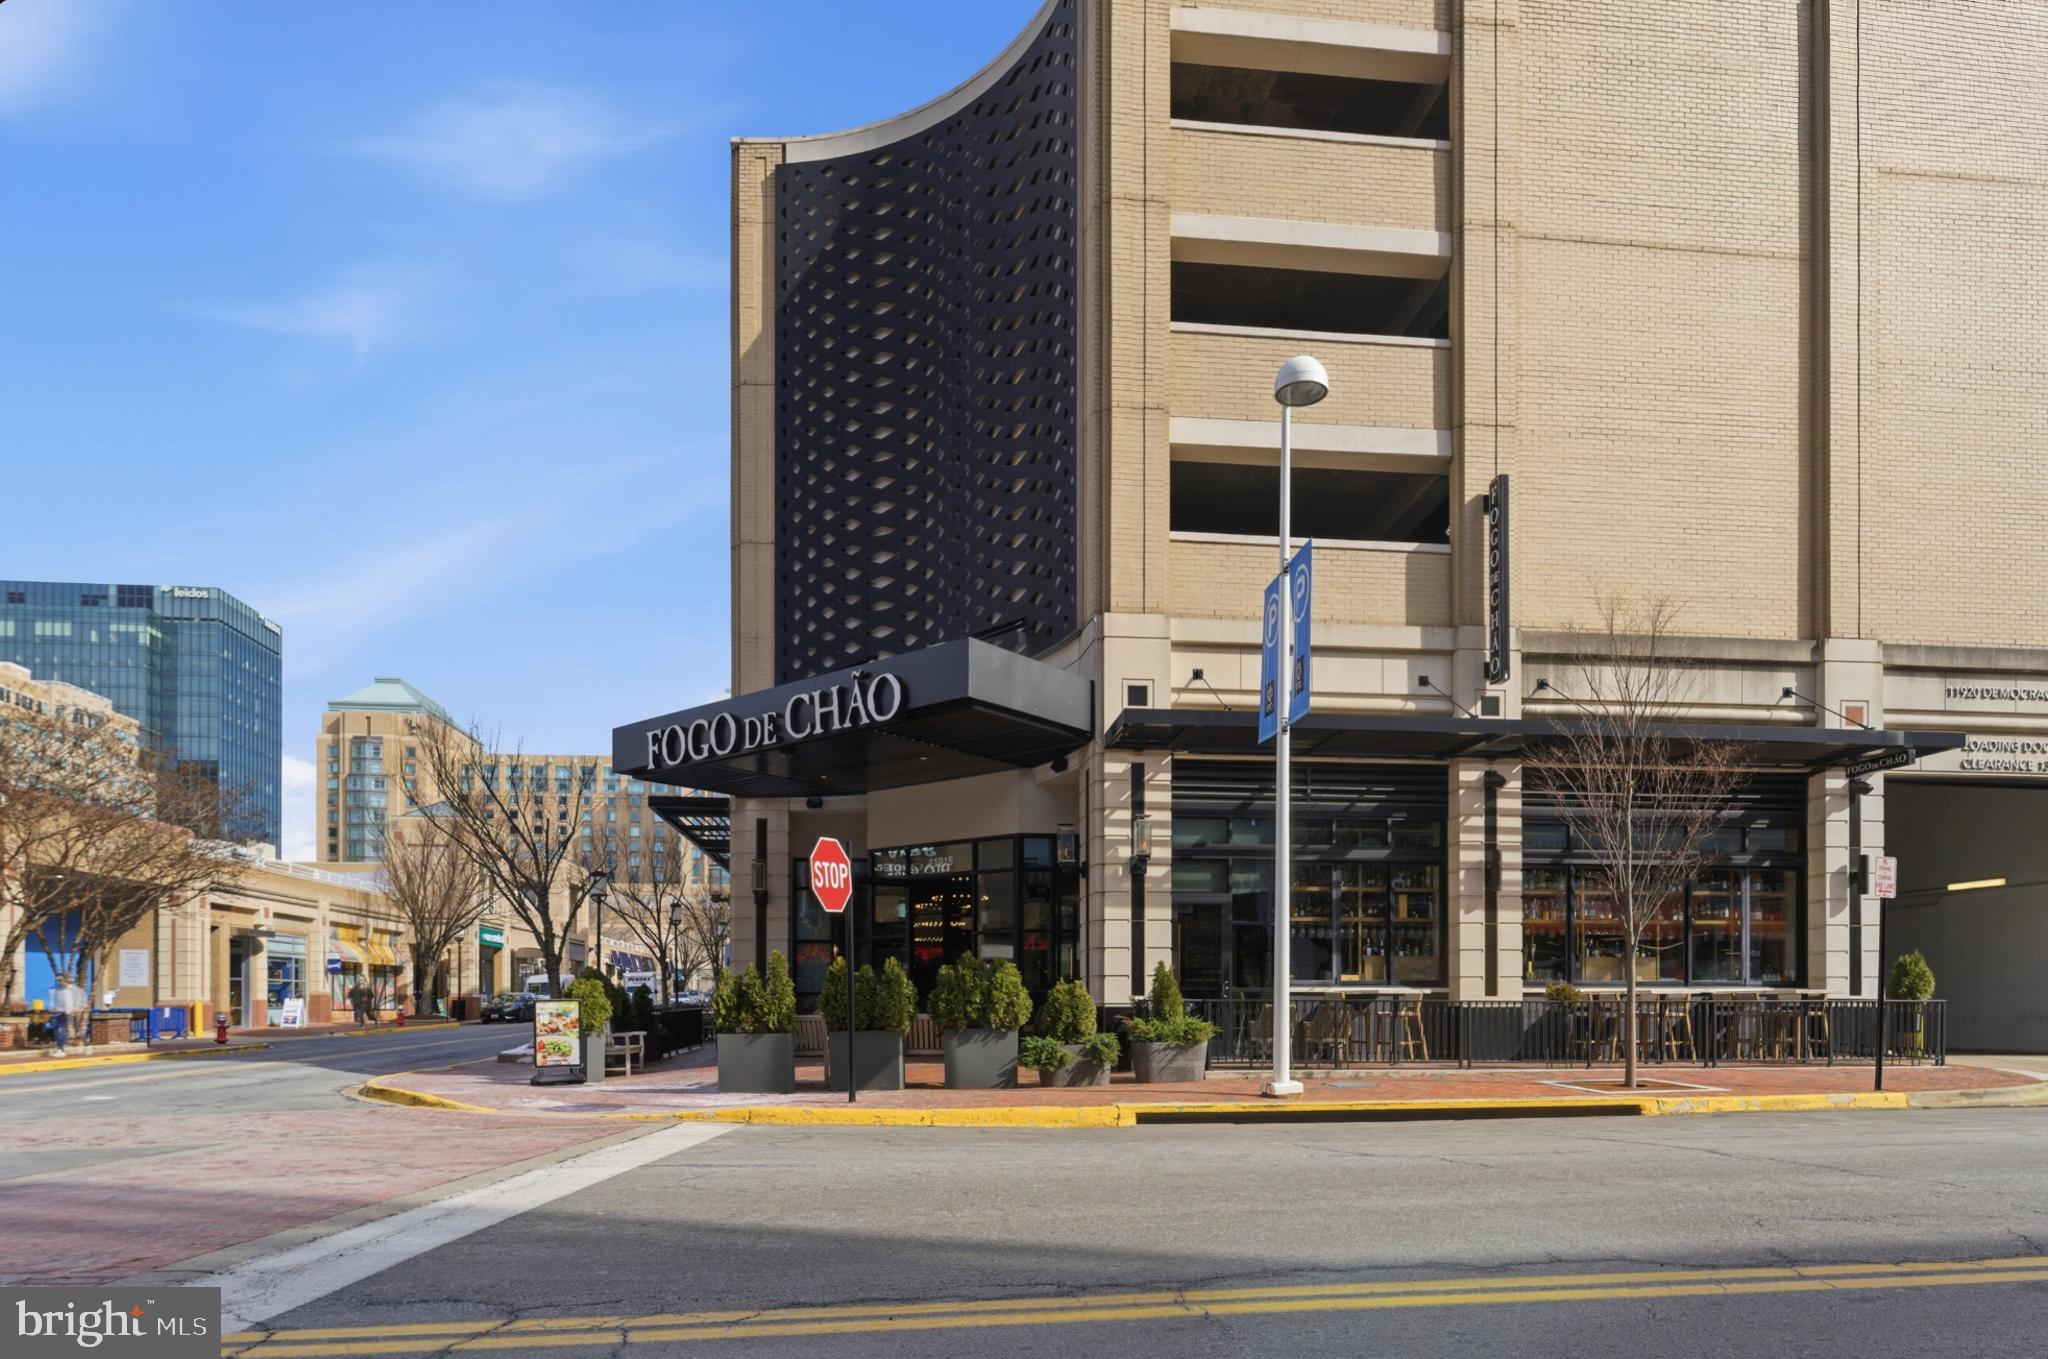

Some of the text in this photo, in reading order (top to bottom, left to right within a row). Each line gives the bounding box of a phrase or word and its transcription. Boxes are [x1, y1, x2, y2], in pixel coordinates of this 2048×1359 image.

[1489, 486, 1500, 568] FOGO
[173, 587, 209, 599] leidos
[1946, 687, 1980, 700] 11920
[647, 669, 902, 770] FOGO DE CHÃO
[1960, 758, 2033, 772] CLEARANCE
[814, 860, 848, 889] STOP
